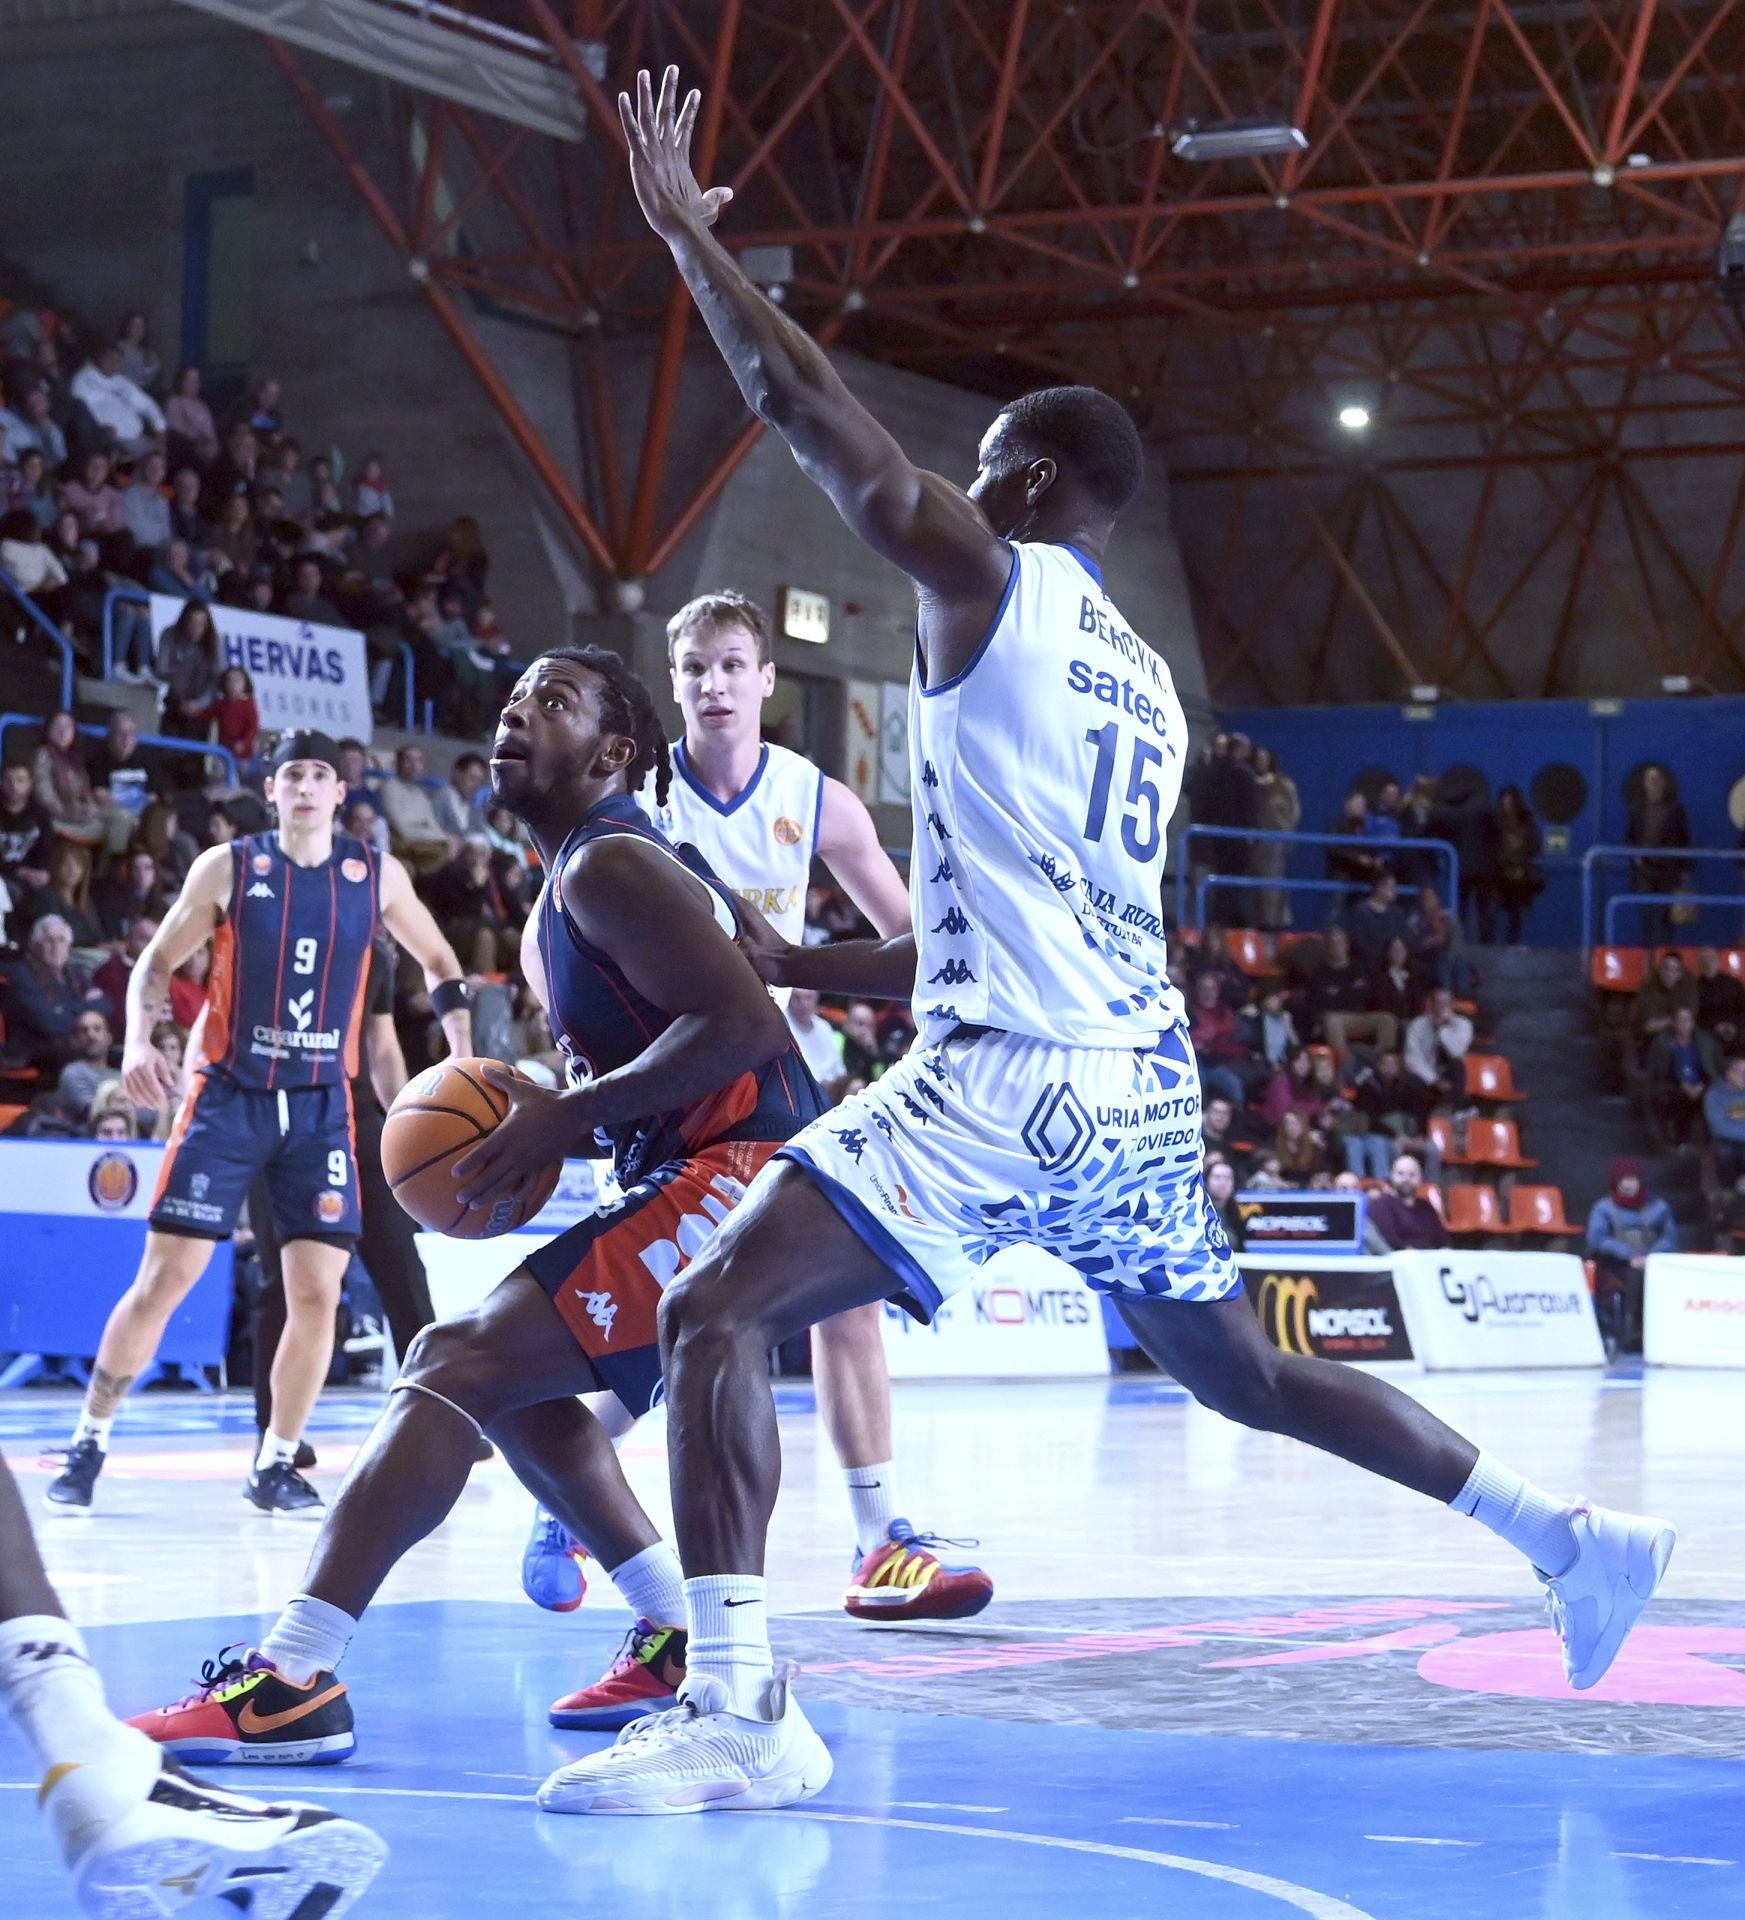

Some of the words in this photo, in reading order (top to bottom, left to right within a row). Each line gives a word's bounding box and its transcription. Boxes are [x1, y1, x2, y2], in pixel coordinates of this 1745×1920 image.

[224, 634, 345, 684] HERVAS
[1083, 720, 1163, 864] 15
[293, 937, 318, 975] 9
[1137, 1128, 1194, 1152] OVIEDO
[327, 1149, 348, 1187] 9
[972, 1289, 1089, 1325] KOMTES
